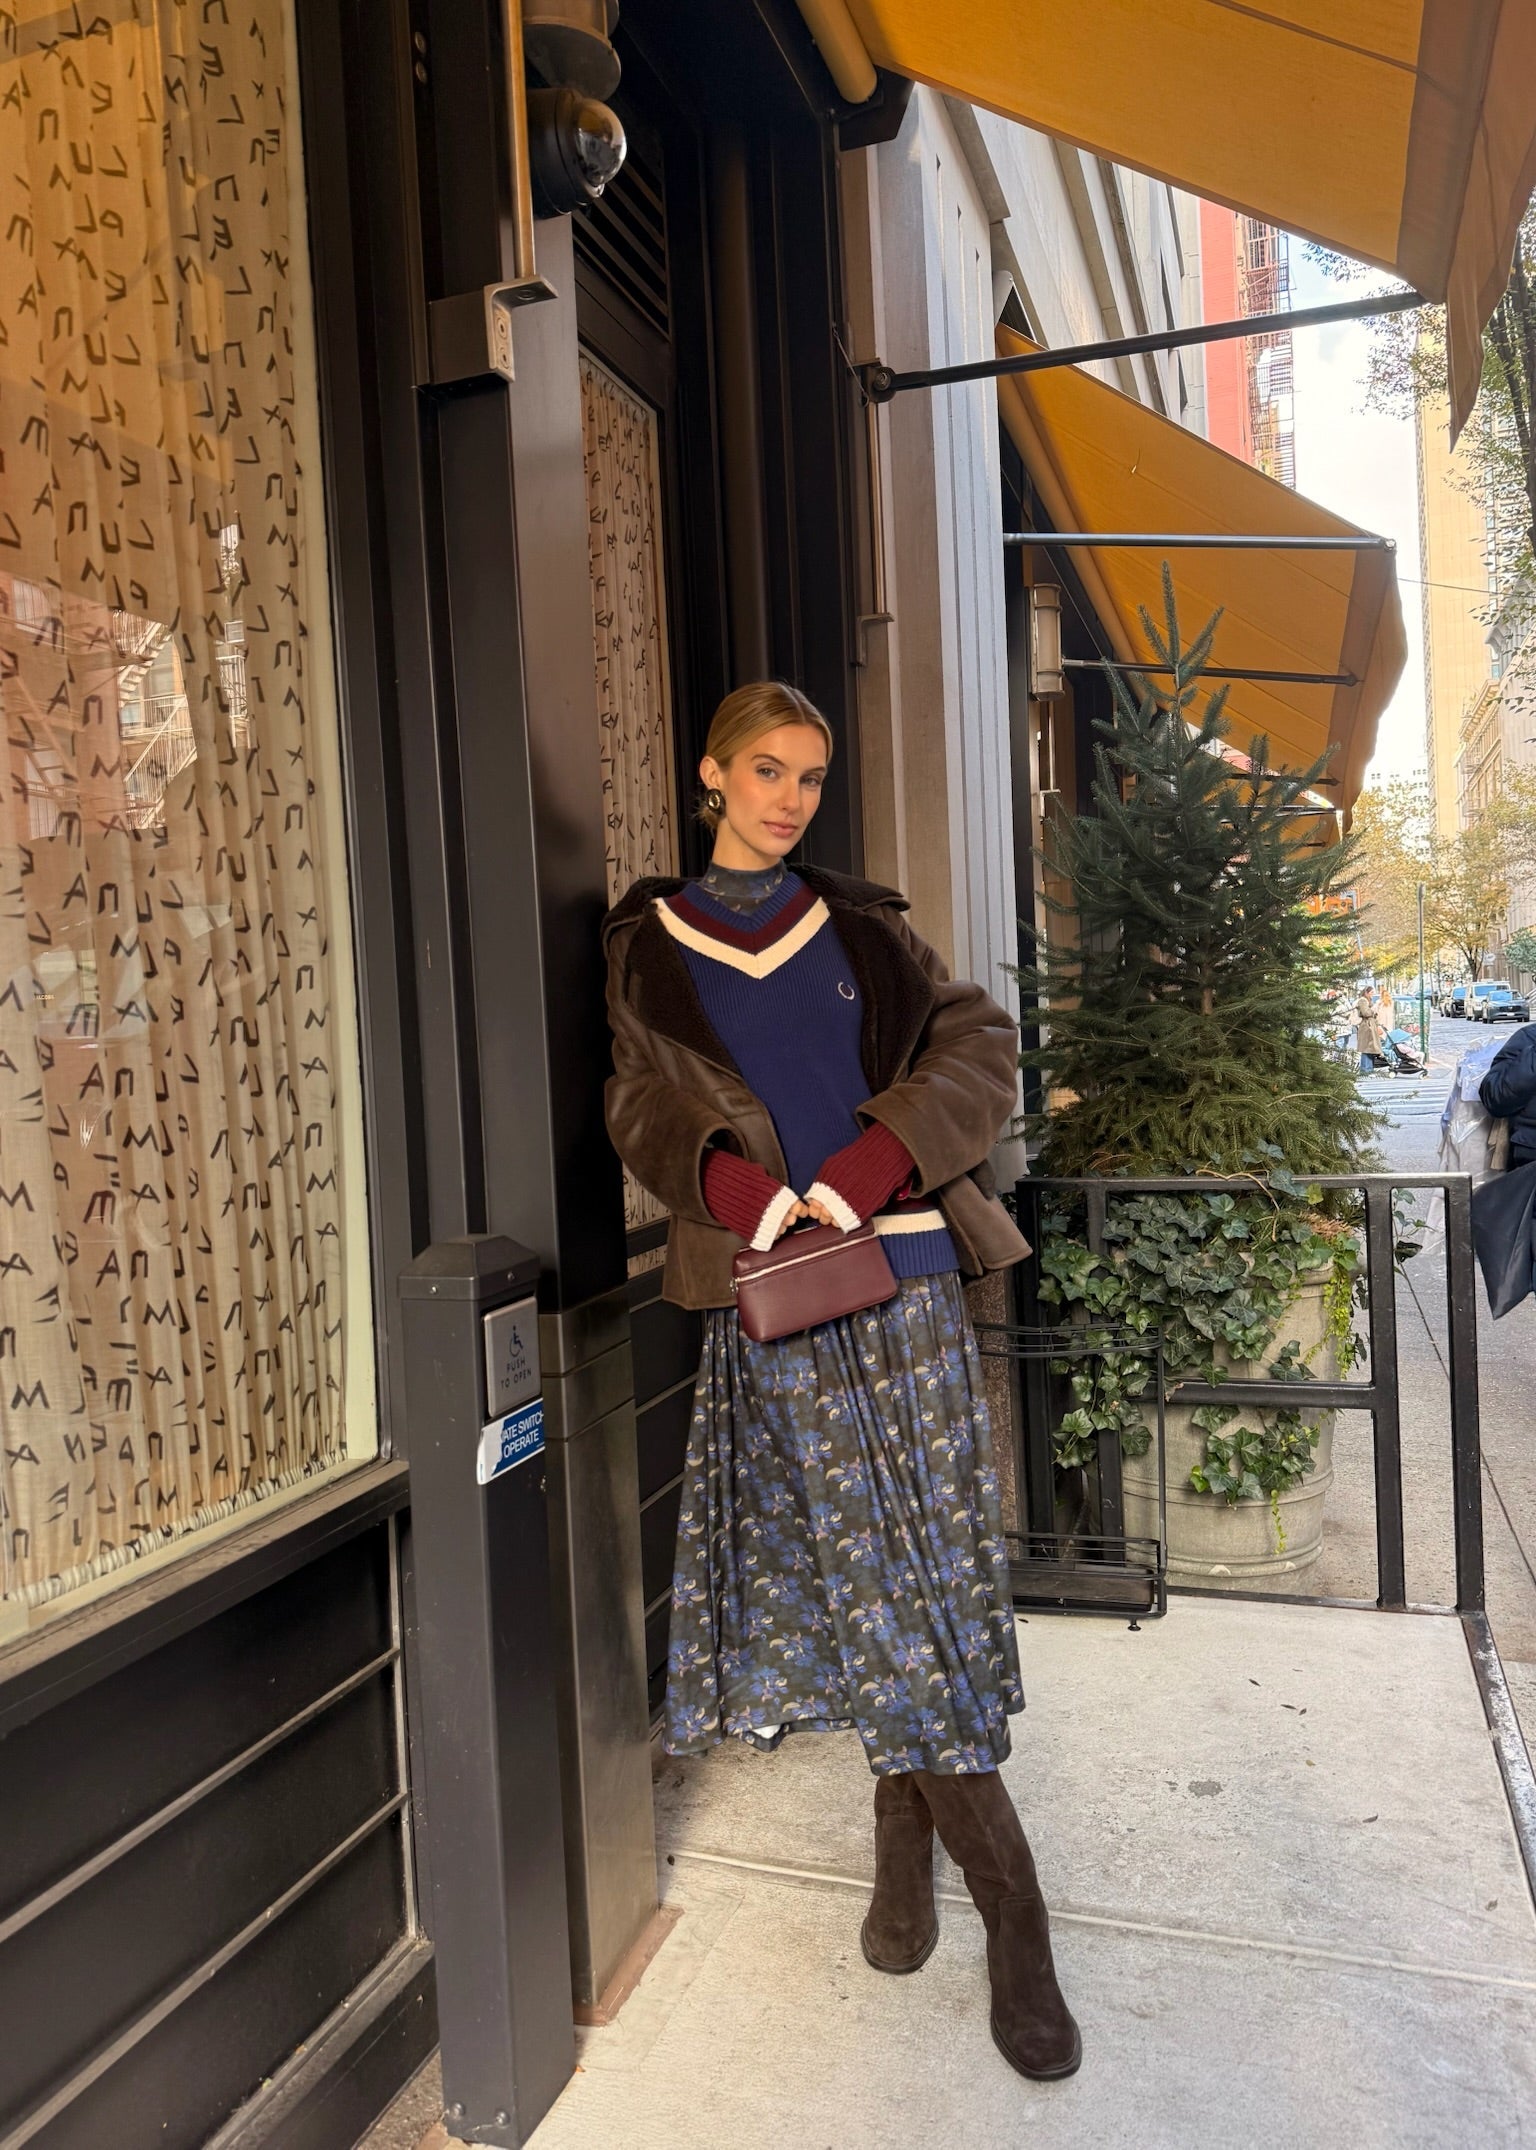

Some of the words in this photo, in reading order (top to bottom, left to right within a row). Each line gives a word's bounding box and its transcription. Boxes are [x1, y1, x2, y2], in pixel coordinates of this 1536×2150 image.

[507, 1358, 526, 1374] PUSH
[500, 1378, 510, 1389] TO
[514, 1367, 532, 1384] OPEN
[501, 1423, 518, 1443] ATE
[503, 1428, 540, 1459] OPERATE
